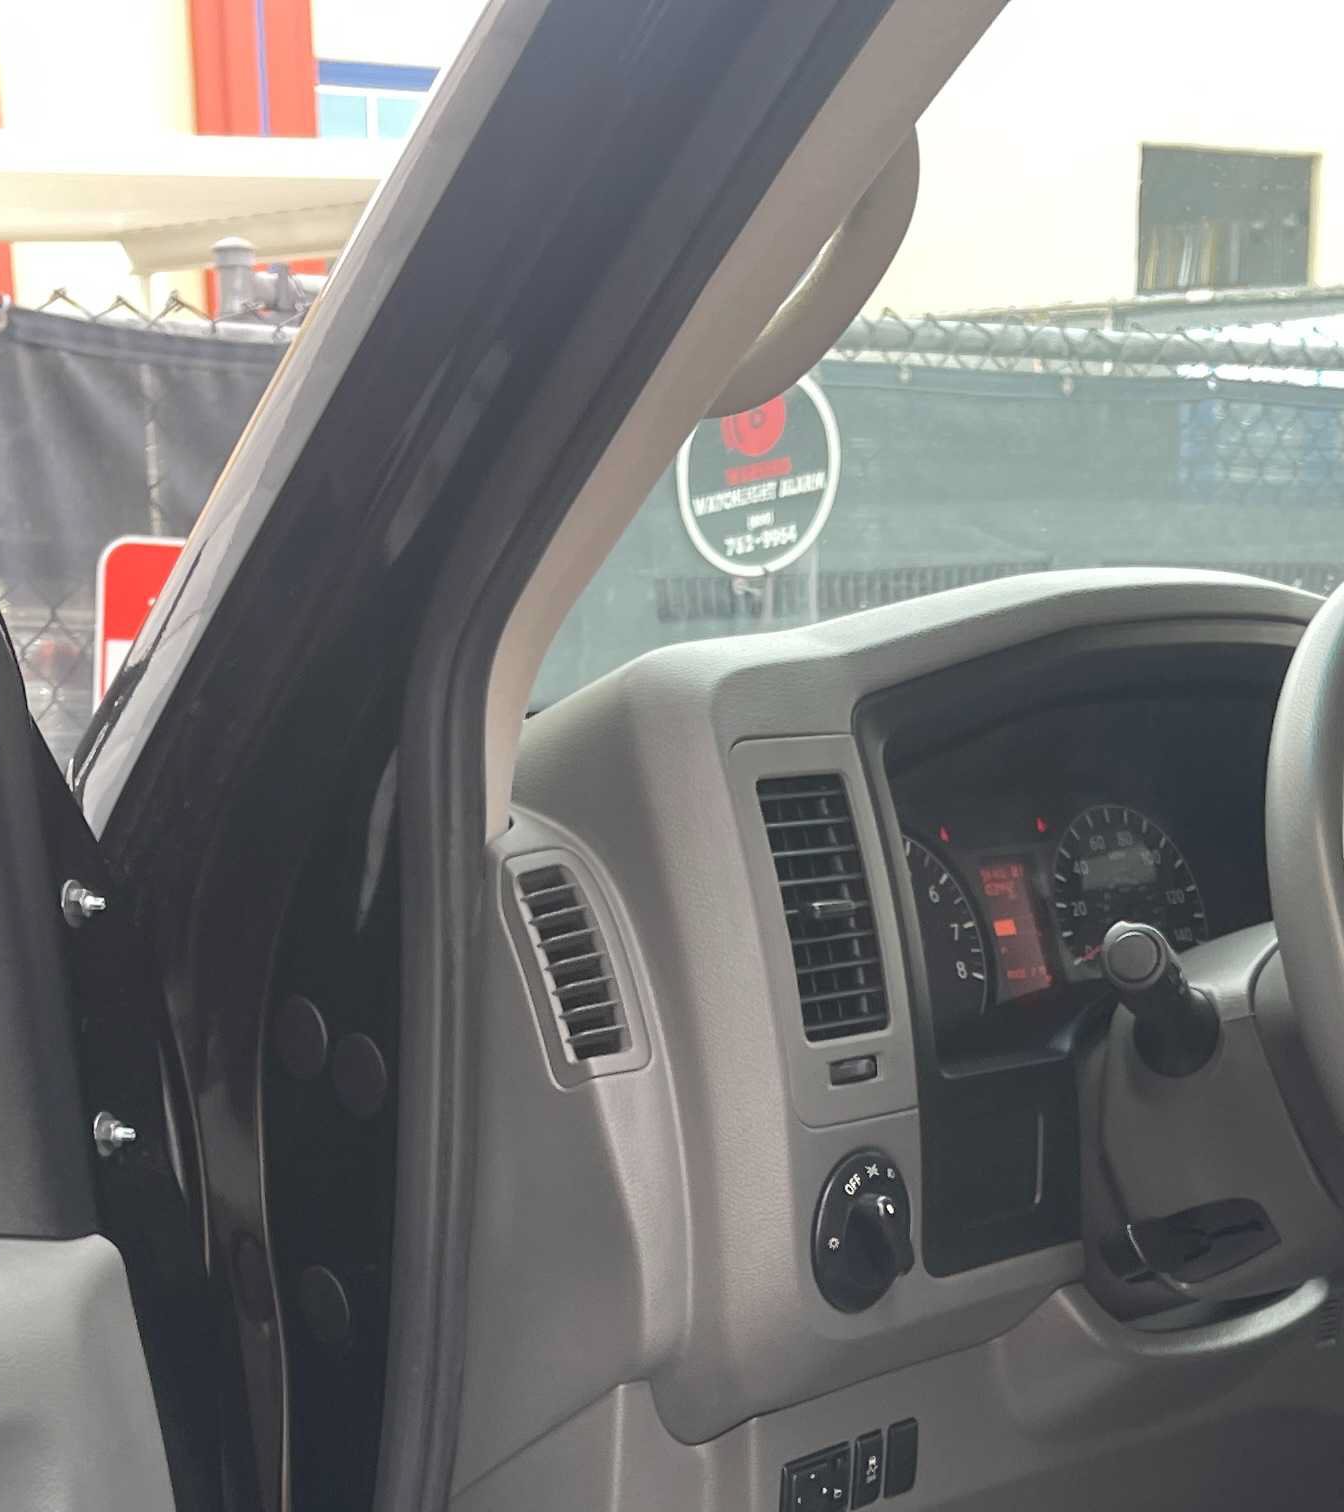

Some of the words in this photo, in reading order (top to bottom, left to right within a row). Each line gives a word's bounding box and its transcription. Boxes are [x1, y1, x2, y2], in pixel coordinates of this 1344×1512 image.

[928, 884, 941, 904] 6
[1071, 900, 1088, 917] 20
[956, 960, 968, 980] 8
[844, 1172, 862, 1196] OFF
